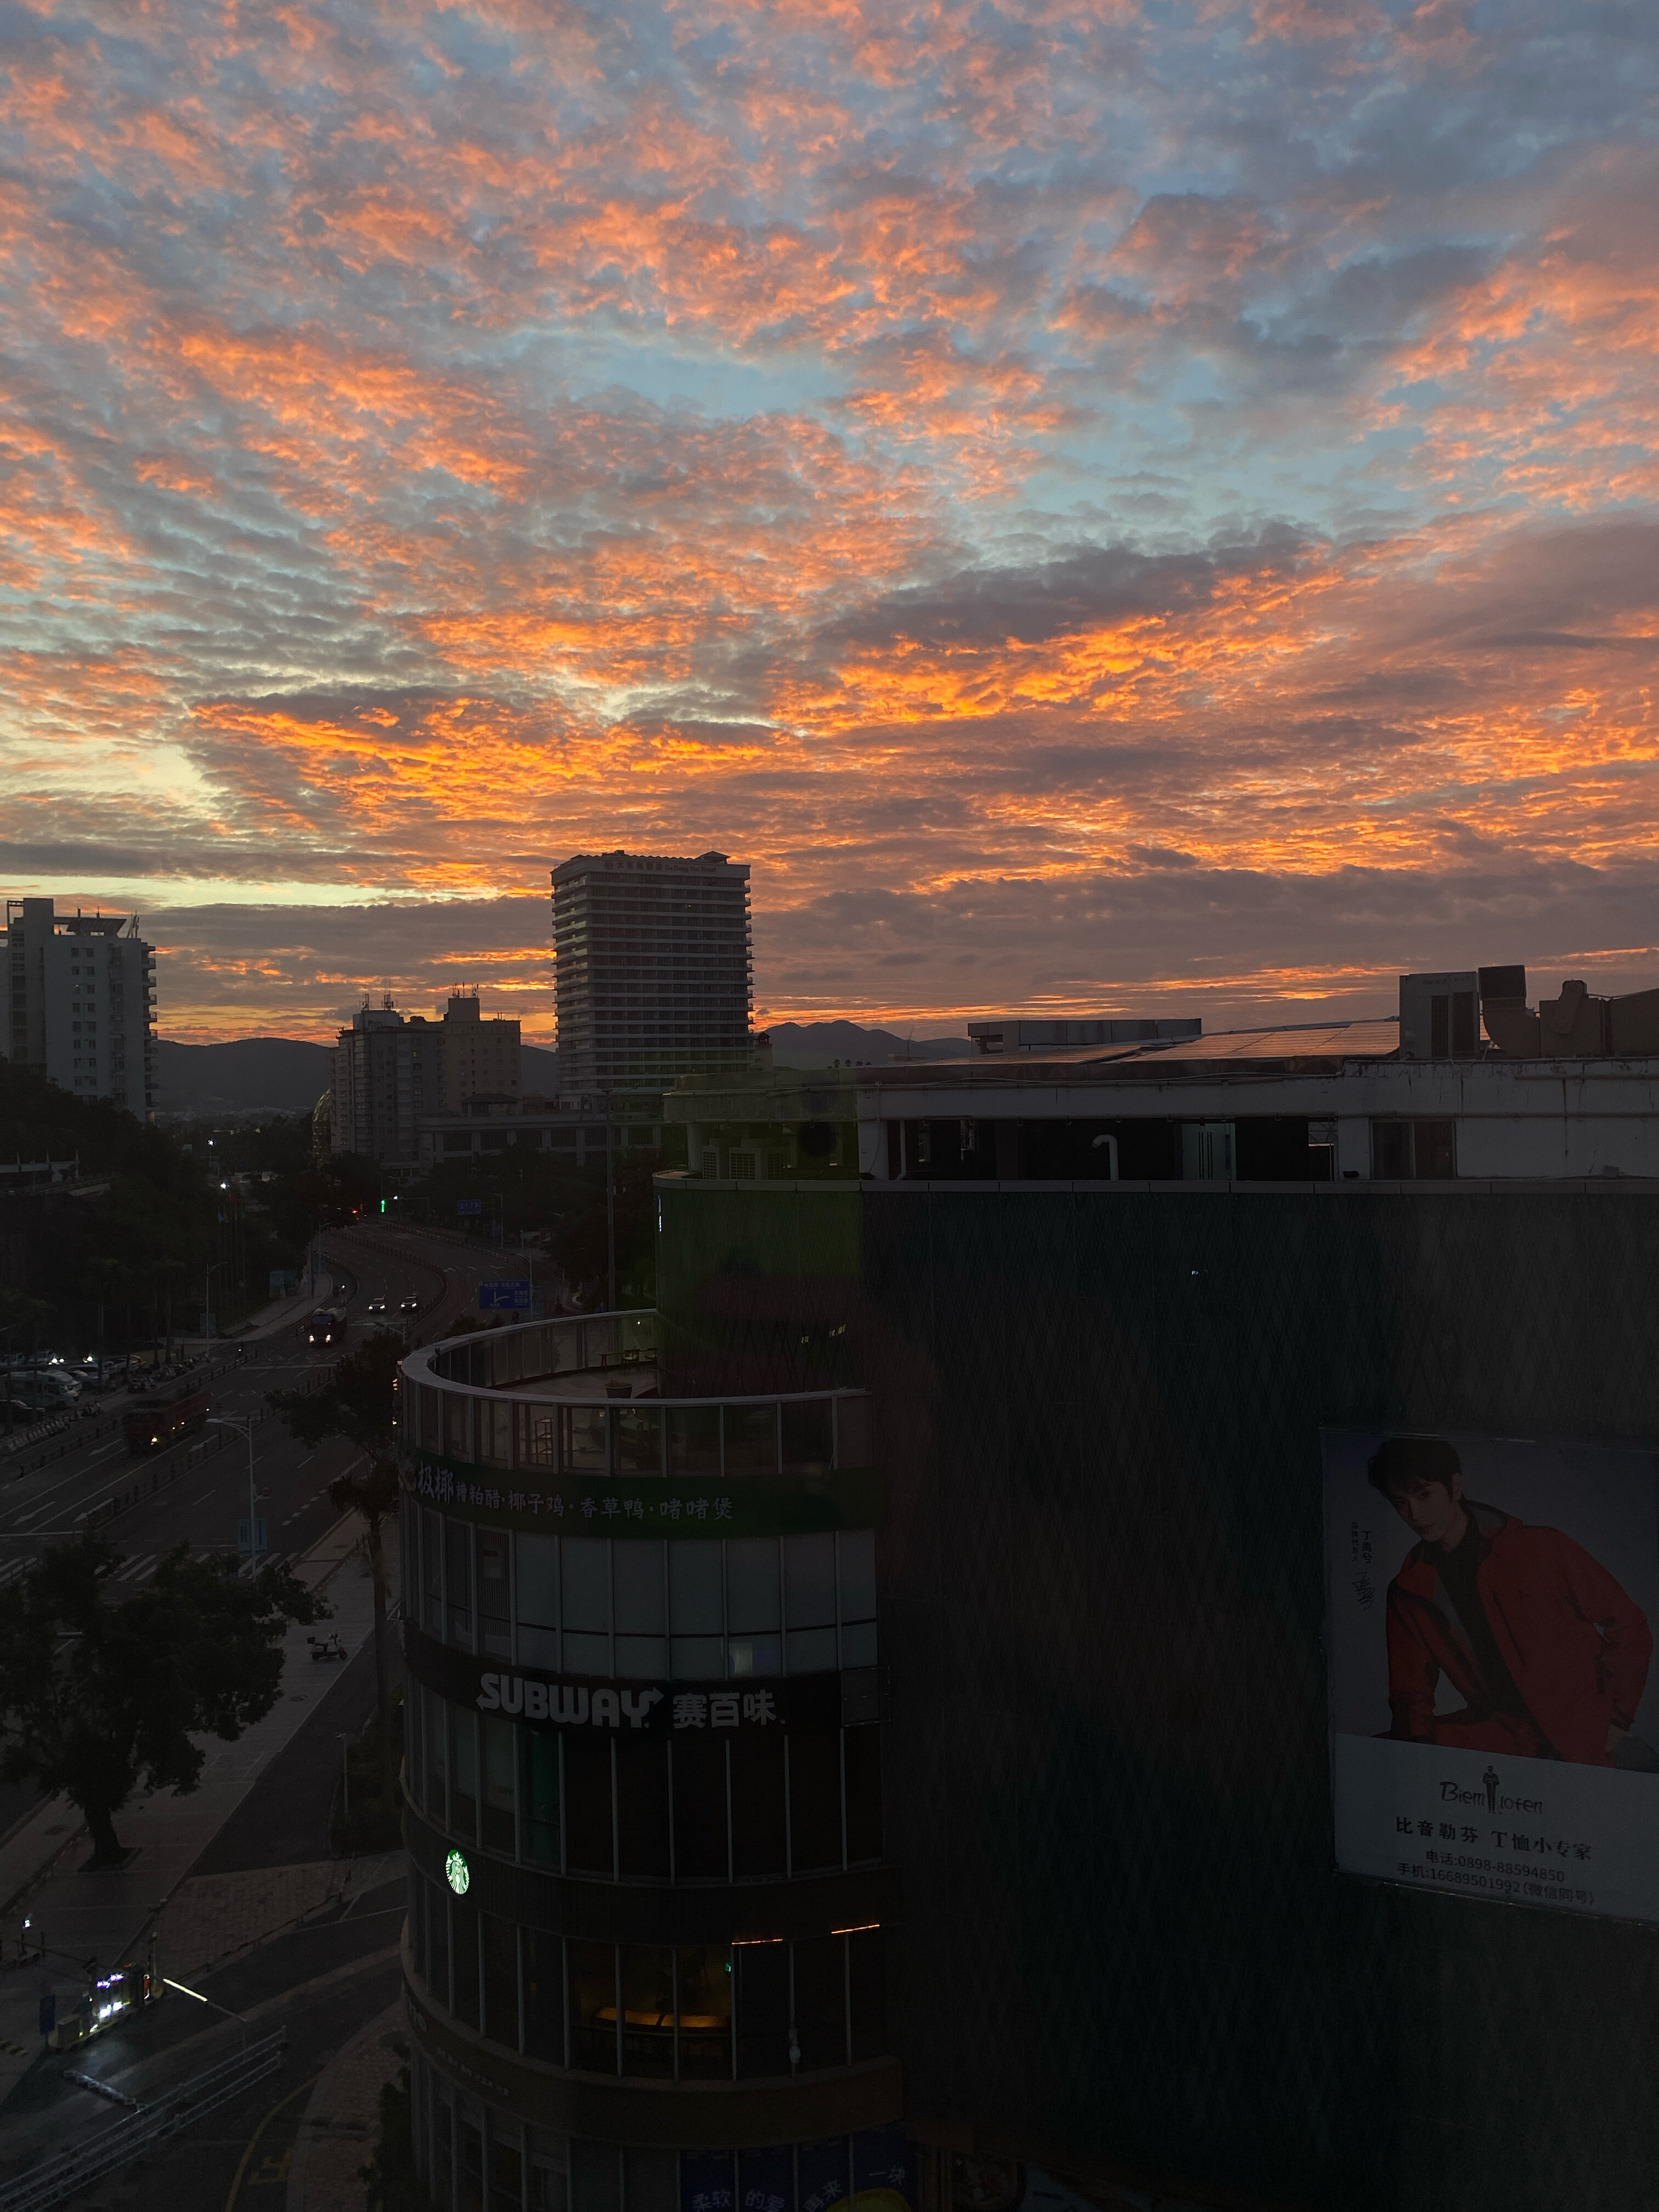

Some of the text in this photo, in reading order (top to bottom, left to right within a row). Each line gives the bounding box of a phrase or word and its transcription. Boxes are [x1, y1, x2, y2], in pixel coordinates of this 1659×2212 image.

[475, 1673, 665, 1729] SUBWAY
[672, 1690, 778, 1729] 赛百味
[1396, 1816, 1593, 1861] 比音勒芬 T恤小专家
[691, 2188, 731, 2212] 柔软
[869, 2164, 906, 2186] 一块
